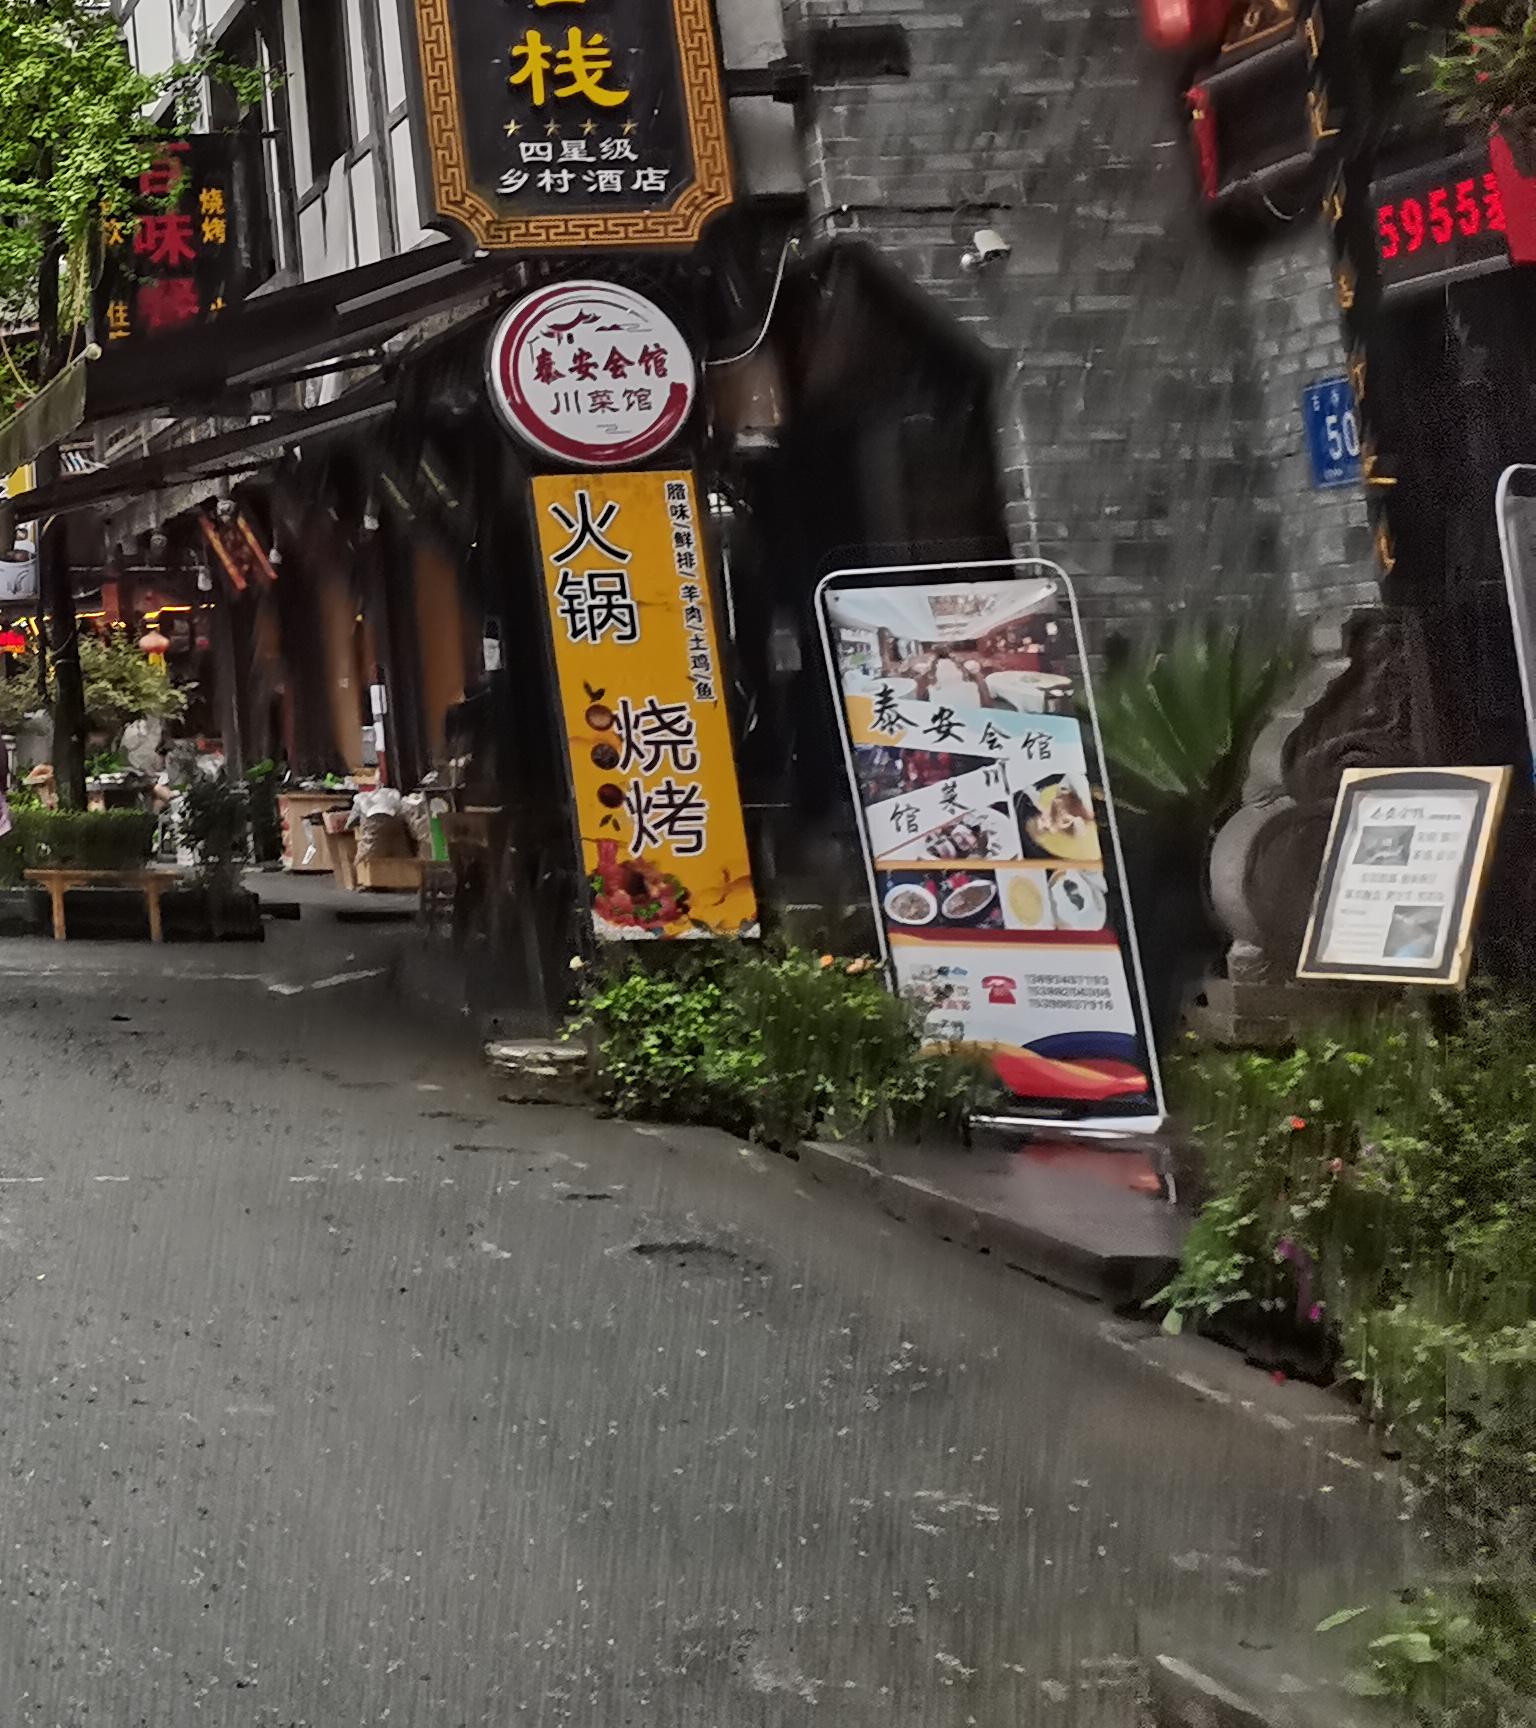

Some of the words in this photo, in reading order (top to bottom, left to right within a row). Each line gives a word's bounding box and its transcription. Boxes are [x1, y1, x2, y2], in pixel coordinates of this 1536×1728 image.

[518, 135, 640, 164] 四星级
[495, 166, 671, 194] 乡村酒店
[533, 343, 669, 385] 泰安会馆
[550, 387, 653, 415] 川菜馆
[550, 491, 639, 643] 火锅
[869, 683, 1054, 762] 泰安会馆
[614, 697, 708, 858] 烧烤
